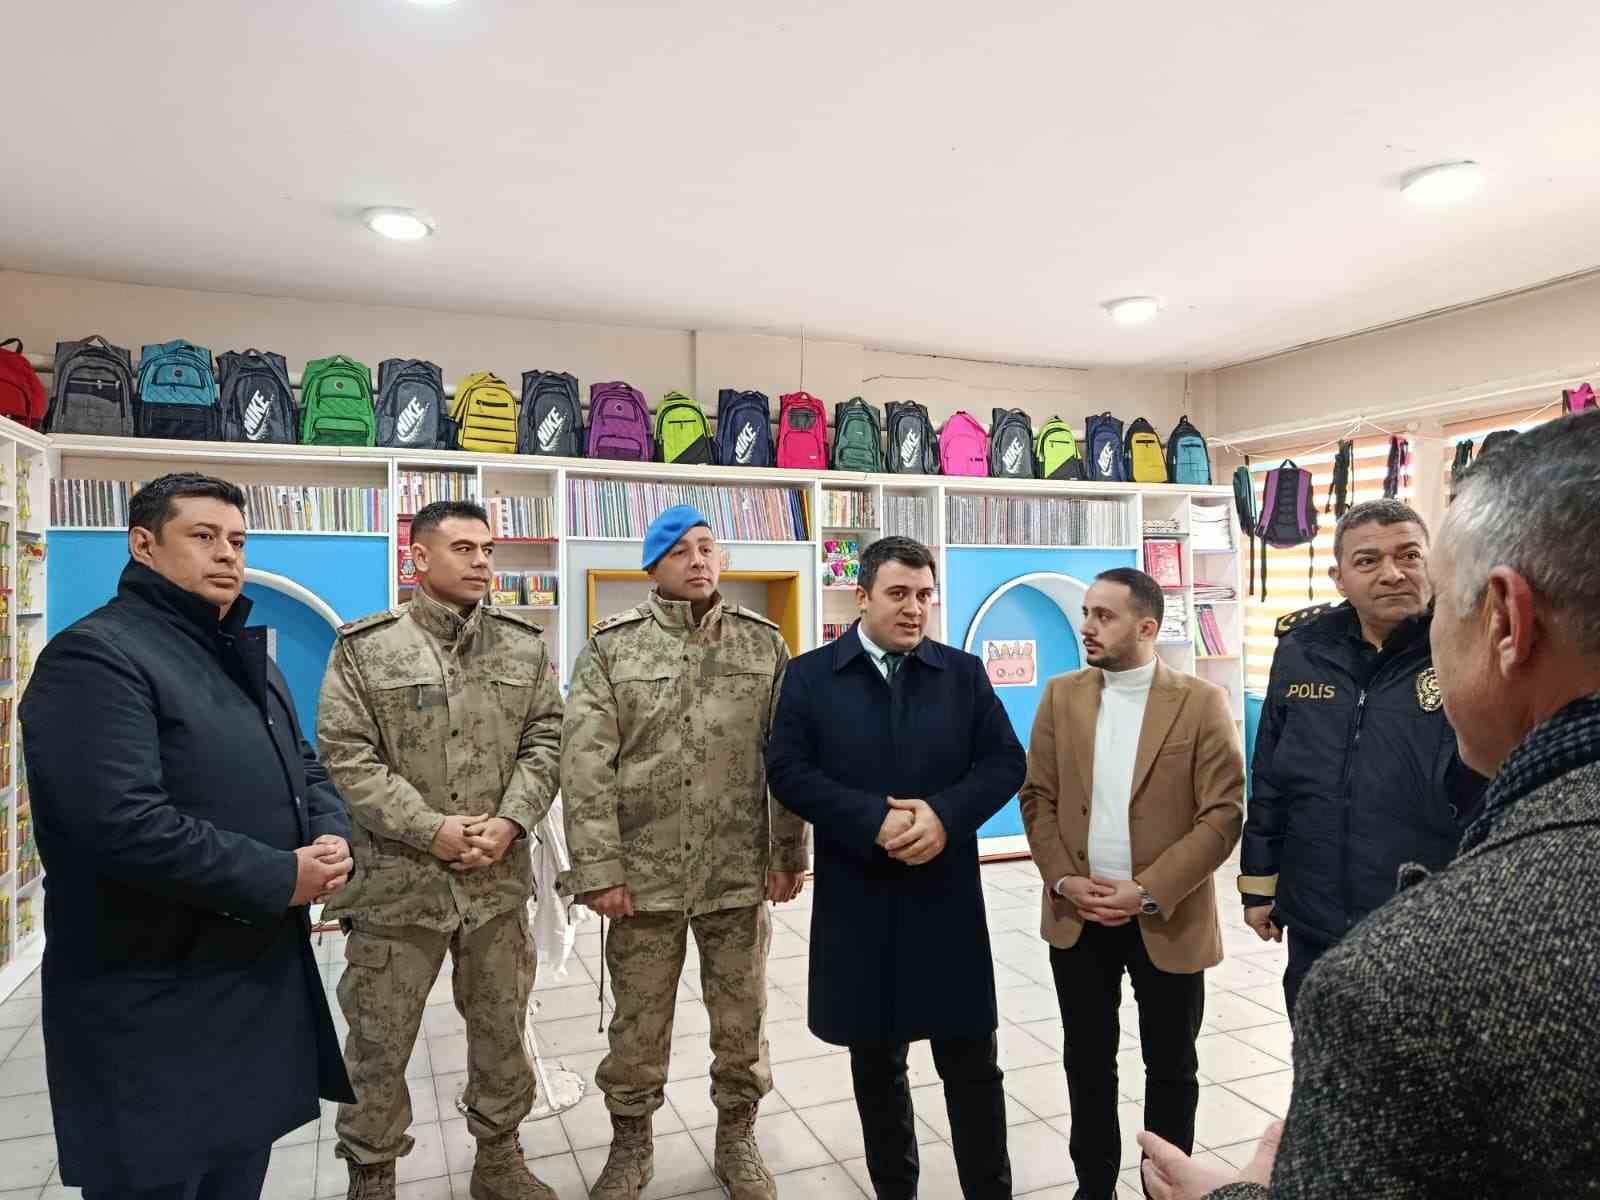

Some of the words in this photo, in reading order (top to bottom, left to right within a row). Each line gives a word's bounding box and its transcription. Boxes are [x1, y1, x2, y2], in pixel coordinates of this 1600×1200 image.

[244, 390, 270, 434] NIKE
[397, 396, 425, 436] NIKE
[537, 406, 564, 446] NIKE
[735, 421, 757, 458] NIKE
[901, 428, 919, 461] NIKE
[1002, 437, 1023, 468] NIKE
